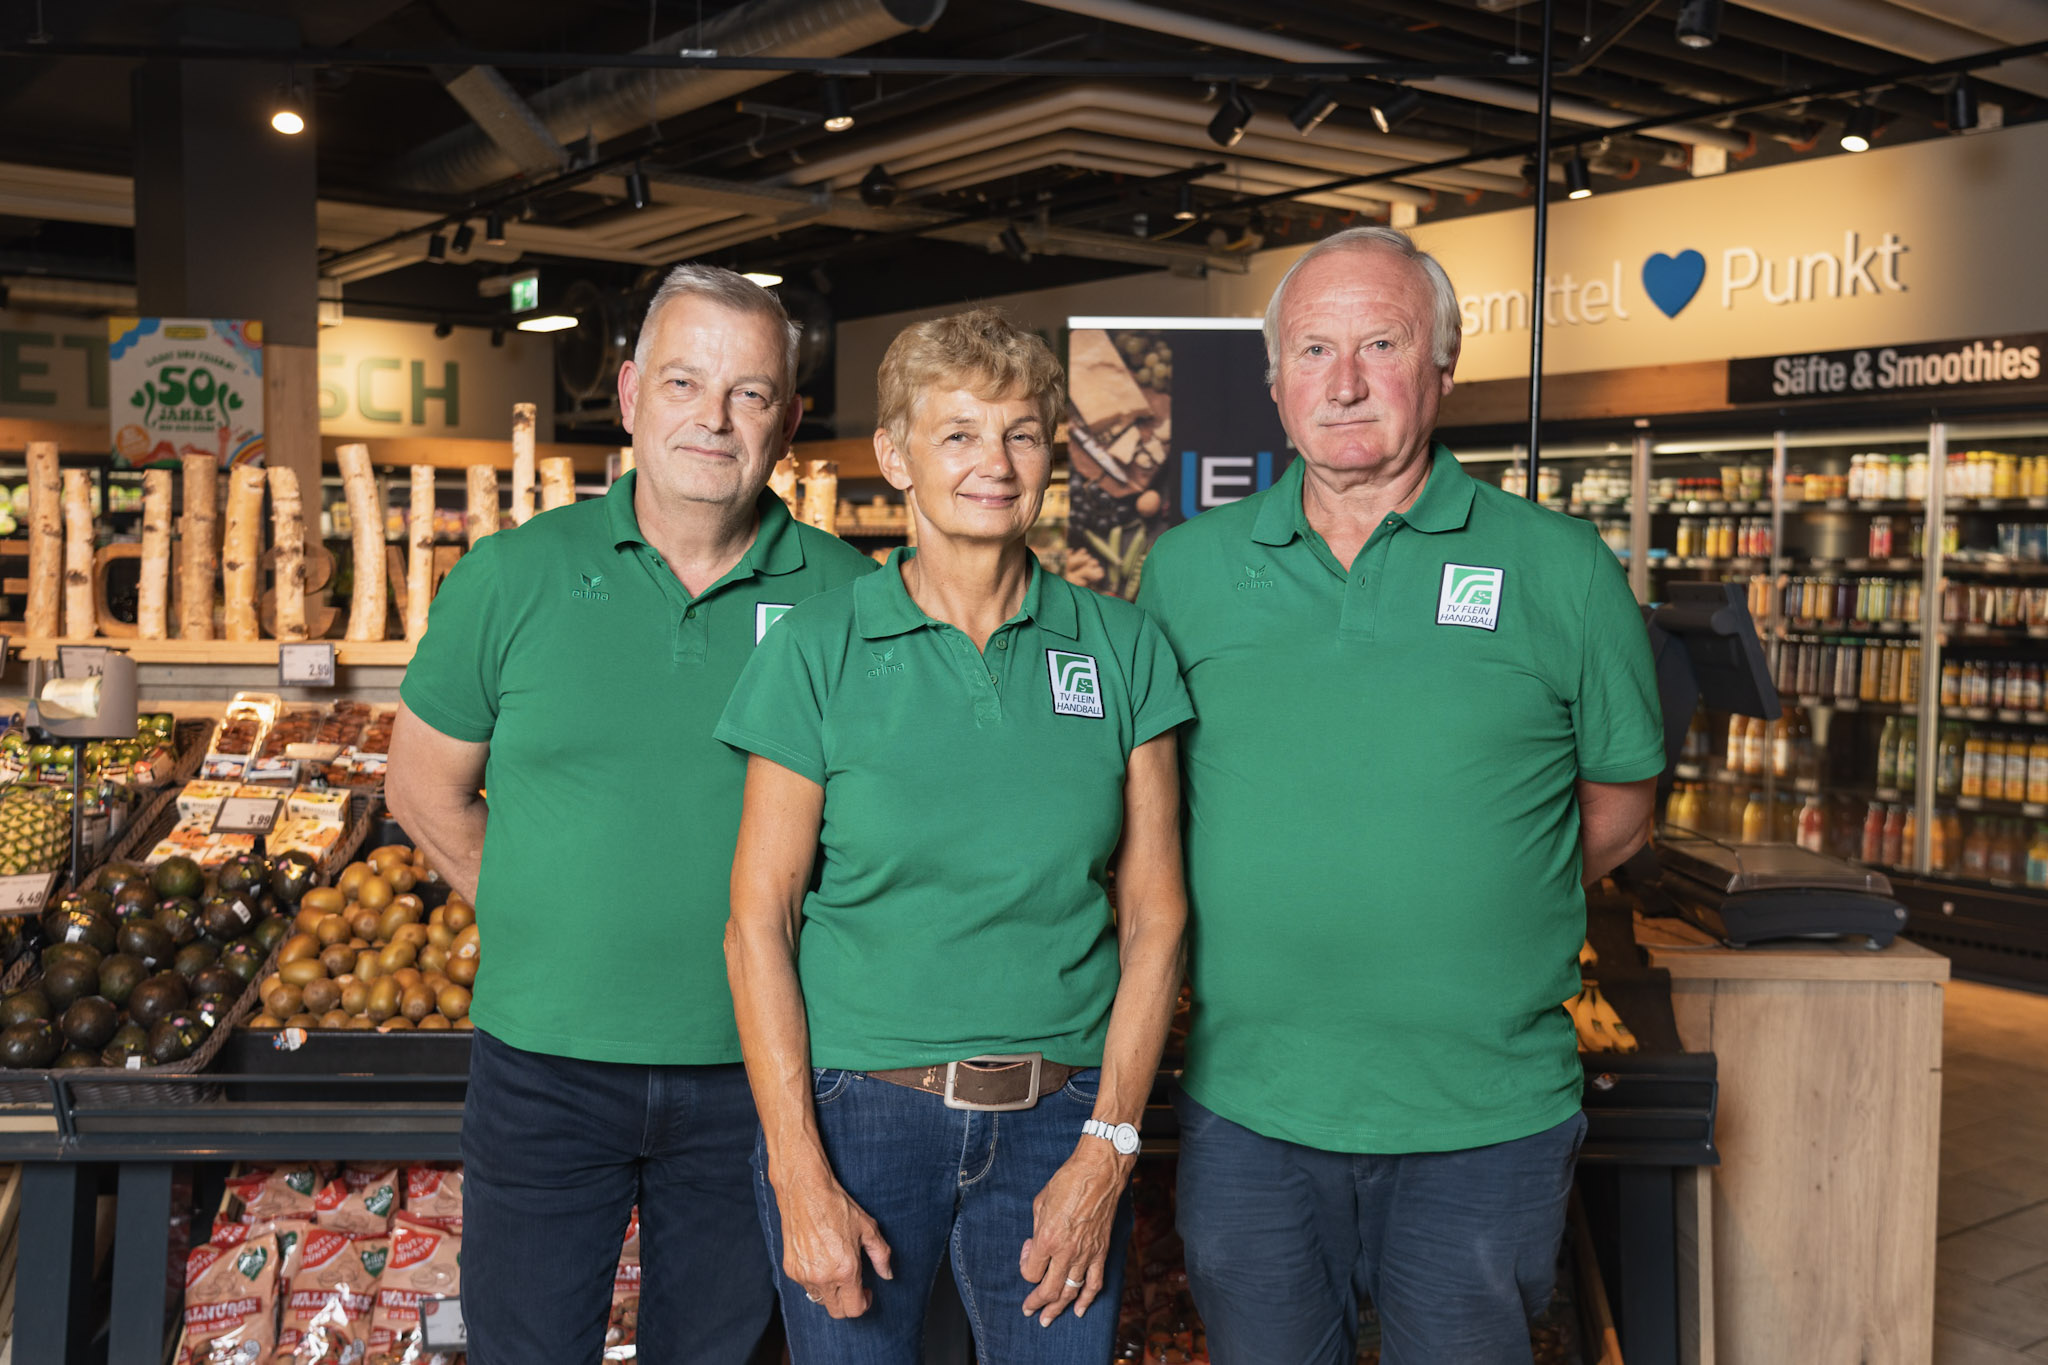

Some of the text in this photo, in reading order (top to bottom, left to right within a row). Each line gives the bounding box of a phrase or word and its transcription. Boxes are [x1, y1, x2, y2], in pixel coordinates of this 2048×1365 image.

[1722, 230, 1906, 310] Punkt
[1772, 339, 2041, 396] Säfte & Smoothies
[158, 366, 216, 407] 50
[158, 407, 216, 422] JAHRE
[1236, 579, 1274, 590] erima
[571, 588, 610, 601] erima
[1446, 604, 1491, 616] TV FLEIN
[1440, 613, 1495, 627] HANDBALL
[867, 662, 905, 678] erima
[1060, 692, 1095, 705] TV FLEIN
[1057, 702, 1101, 715] HANDBALL
